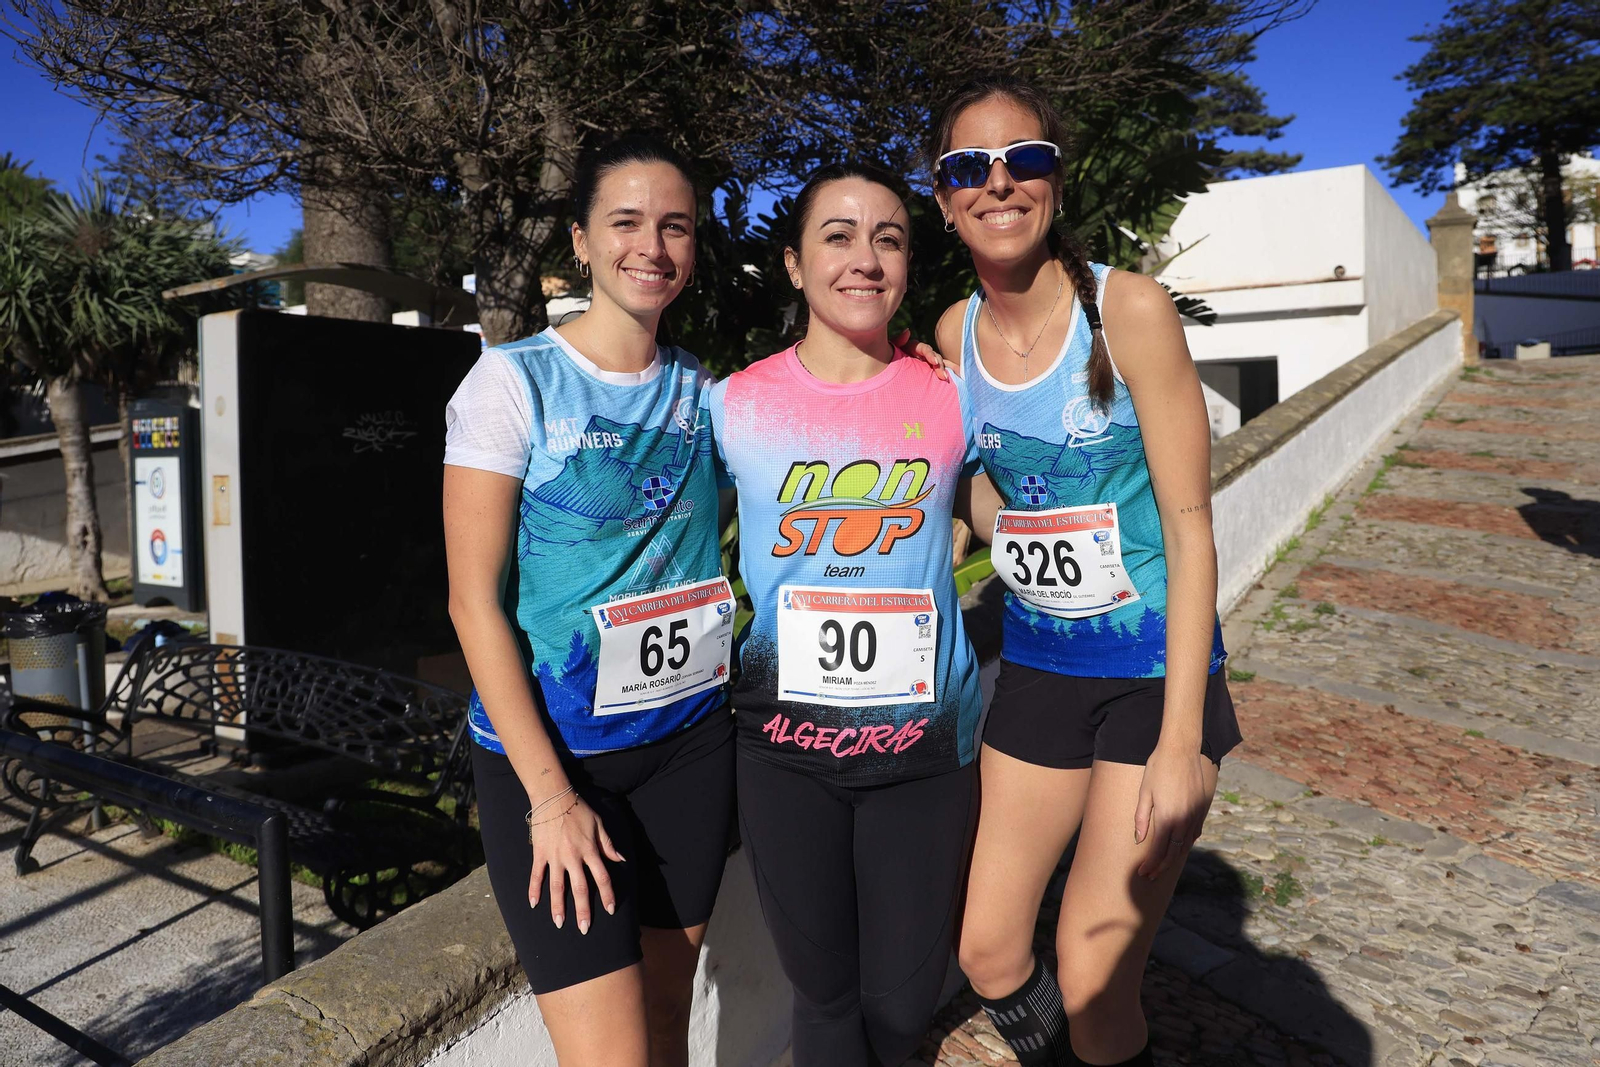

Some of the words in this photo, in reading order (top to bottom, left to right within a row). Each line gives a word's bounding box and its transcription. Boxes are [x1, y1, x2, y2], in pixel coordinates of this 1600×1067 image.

[544, 417, 578, 437] MAT
[547, 432, 624, 453] RUNNERS
[777, 458, 931, 504] non
[1008, 519, 1037, 528] CARRERA
[1037, 519, 1055, 528] DEL
[1056, 511, 1113, 527] ESTRECHO
[771, 508, 926, 557] STOP
[823, 563, 866, 577] team
[1006, 540, 1082, 587] 326
[628, 599, 671, 616] CARRERA
[671, 595, 687, 606] DEL
[687, 585, 727, 602] ESTRECHO
[812, 595, 857, 606] CARRERA
[859, 597, 880, 606] DEL
[881, 596, 929, 607] ESTRECHO
[1037, 590, 1049, 598] DEL
[1050, 589, 1072, 598] ROCÍO
[640, 618, 691, 677] 65
[721, 640, 725, 648] S
[818, 619, 877, 673] 90
[621, 681, 647, 693] MARÍA
[649, 673, 681, 689] ROSARIO
[822, 675, 853, 685] MIRIAM
[762, 713, 930, 758] ALGECIRAS
